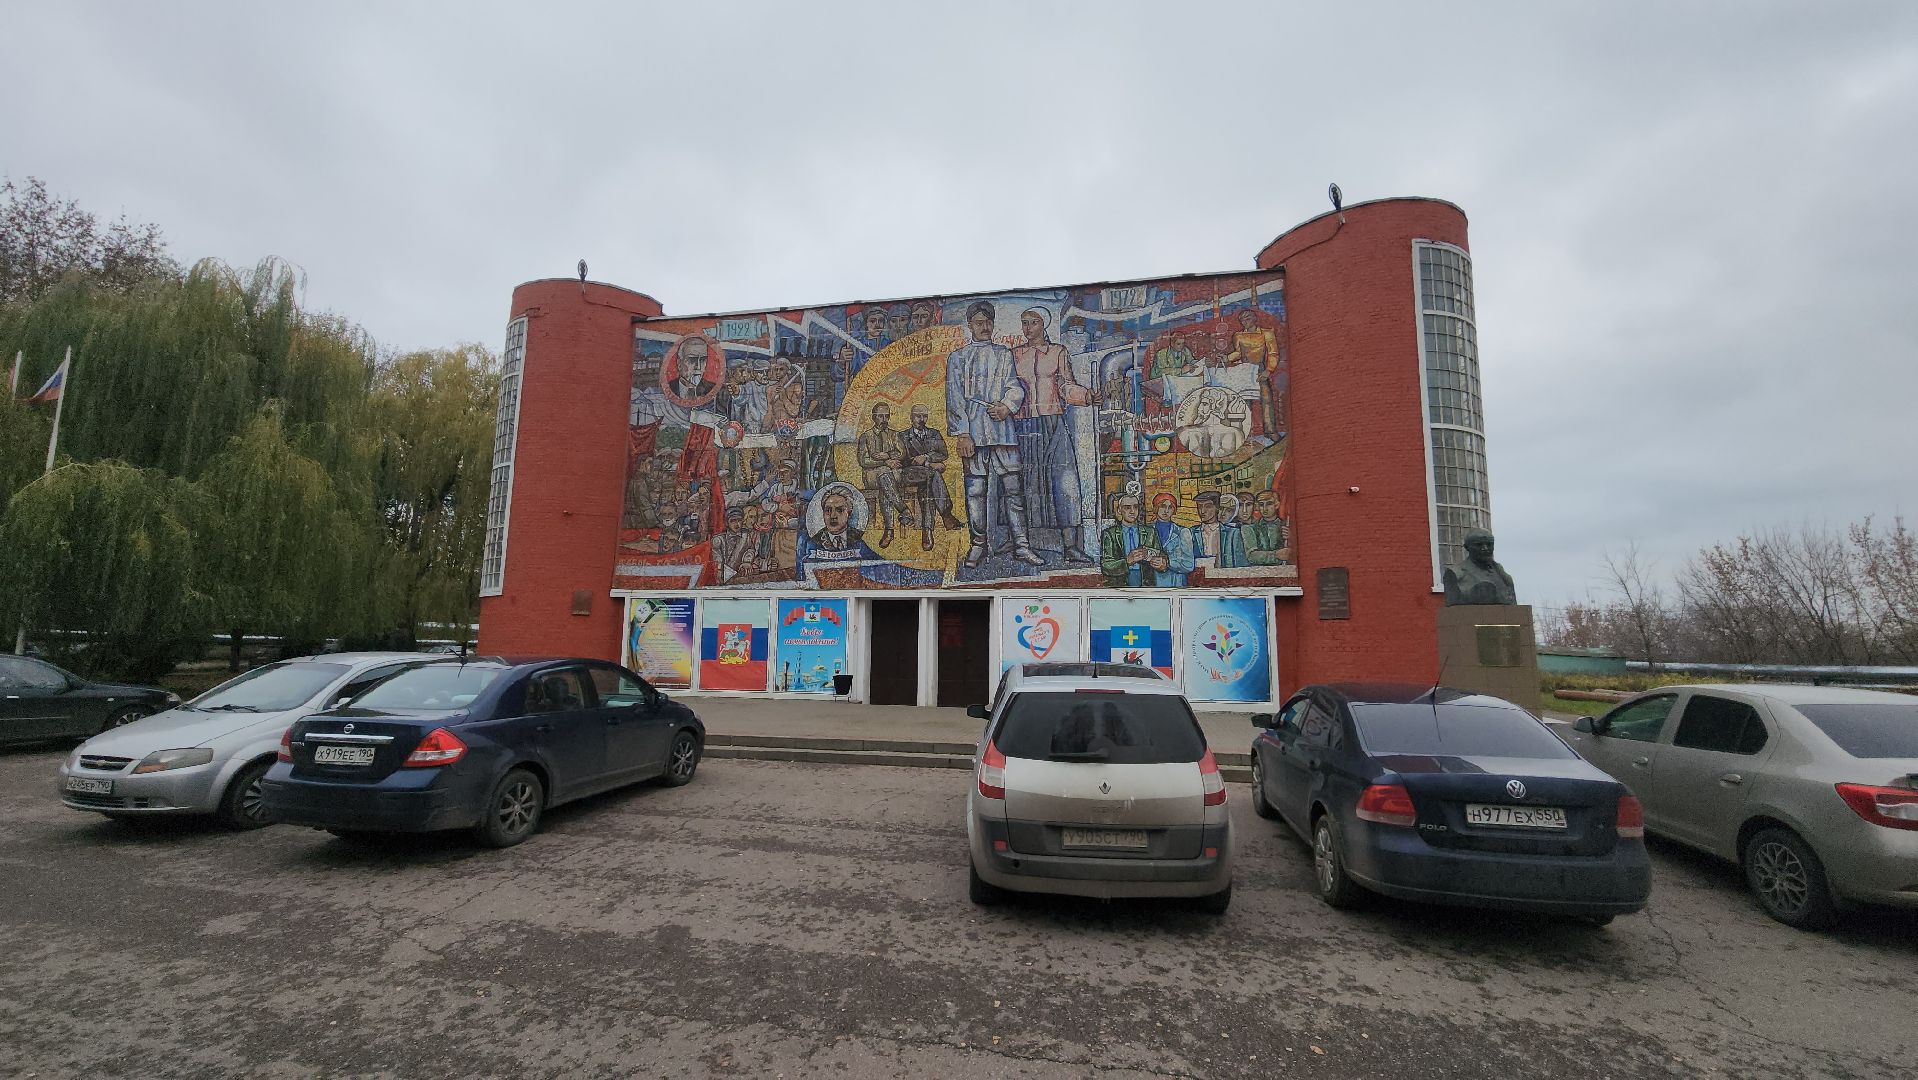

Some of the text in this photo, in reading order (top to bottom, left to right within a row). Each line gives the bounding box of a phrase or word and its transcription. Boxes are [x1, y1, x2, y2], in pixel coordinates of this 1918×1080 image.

[727, 322, 749, 337] 1922
[1472, 807, 1535, 824] Н977ЕХ
[1419, 823, 1447, 831] POLO
